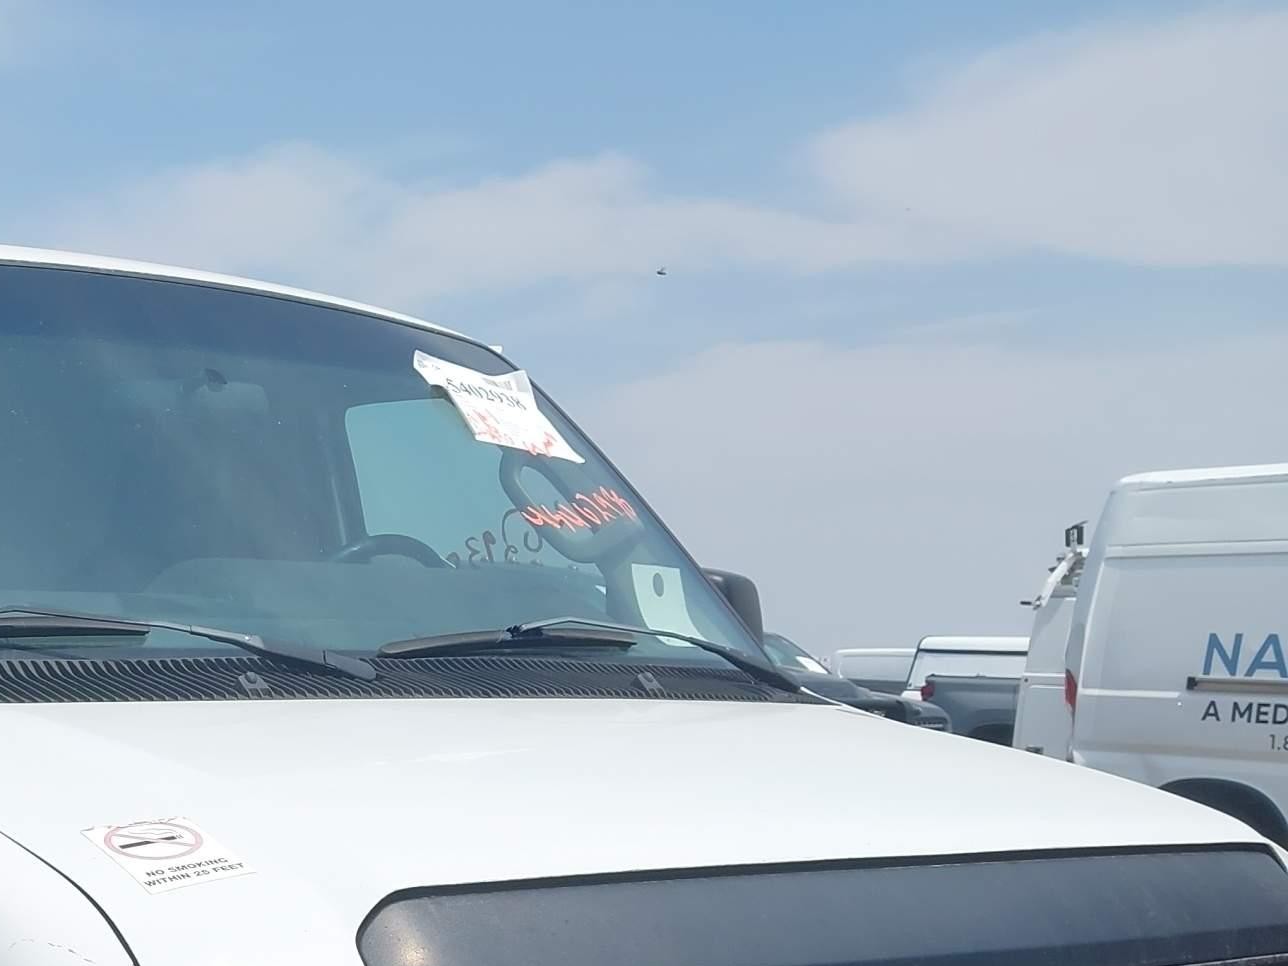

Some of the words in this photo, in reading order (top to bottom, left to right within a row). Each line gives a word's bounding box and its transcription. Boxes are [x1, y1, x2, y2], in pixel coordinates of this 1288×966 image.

[1201, 700, 1221, 721] A
[1231, 701, 1288, 725] MED
[144, 872, 191, 887] WITHIN
[193, 868, 211, 877] 25
[212, 862, 245, 872] FEET
[145, 868, 165, 877] NO
[167, 857, 228, 872] SMOKING
